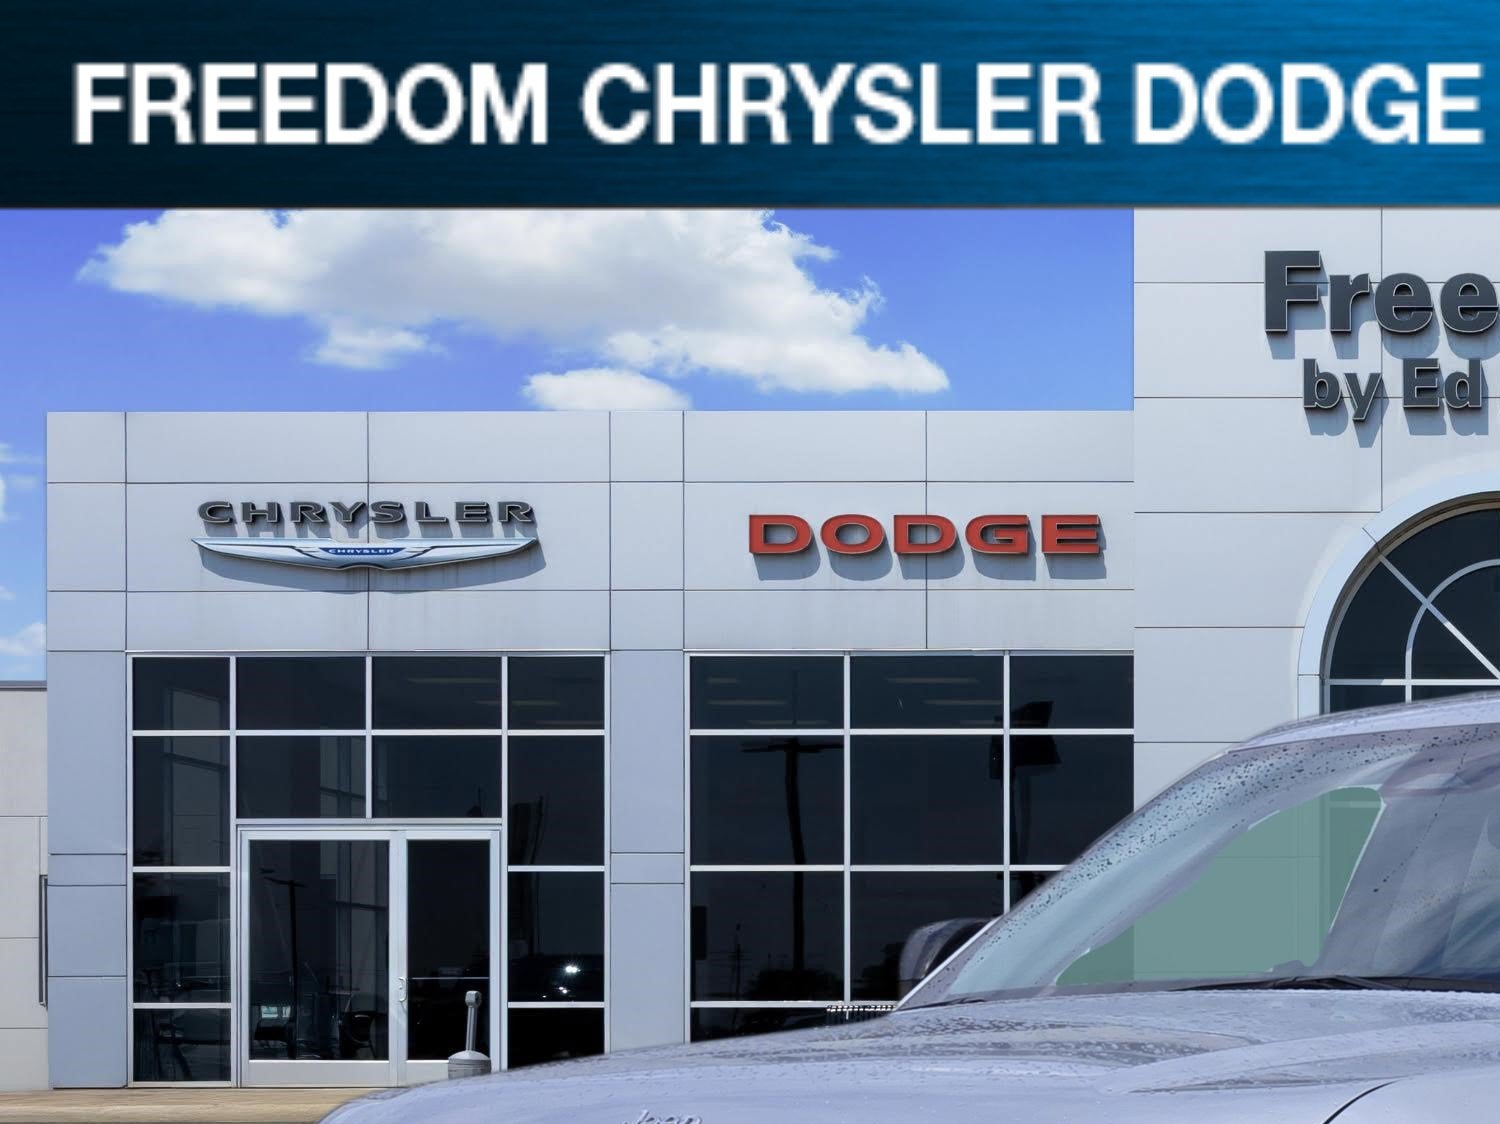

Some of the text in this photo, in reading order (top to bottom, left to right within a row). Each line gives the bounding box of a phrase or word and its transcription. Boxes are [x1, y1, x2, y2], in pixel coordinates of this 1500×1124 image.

[1301, 358, 1384, 422] by
[1401, 357, 1482, 410] Ed
[197, 500, 536, 525] CHRYSLER
[748, 513, 1100, 555] DODGE
[328, 547, 395, 555] CHRYSLER
